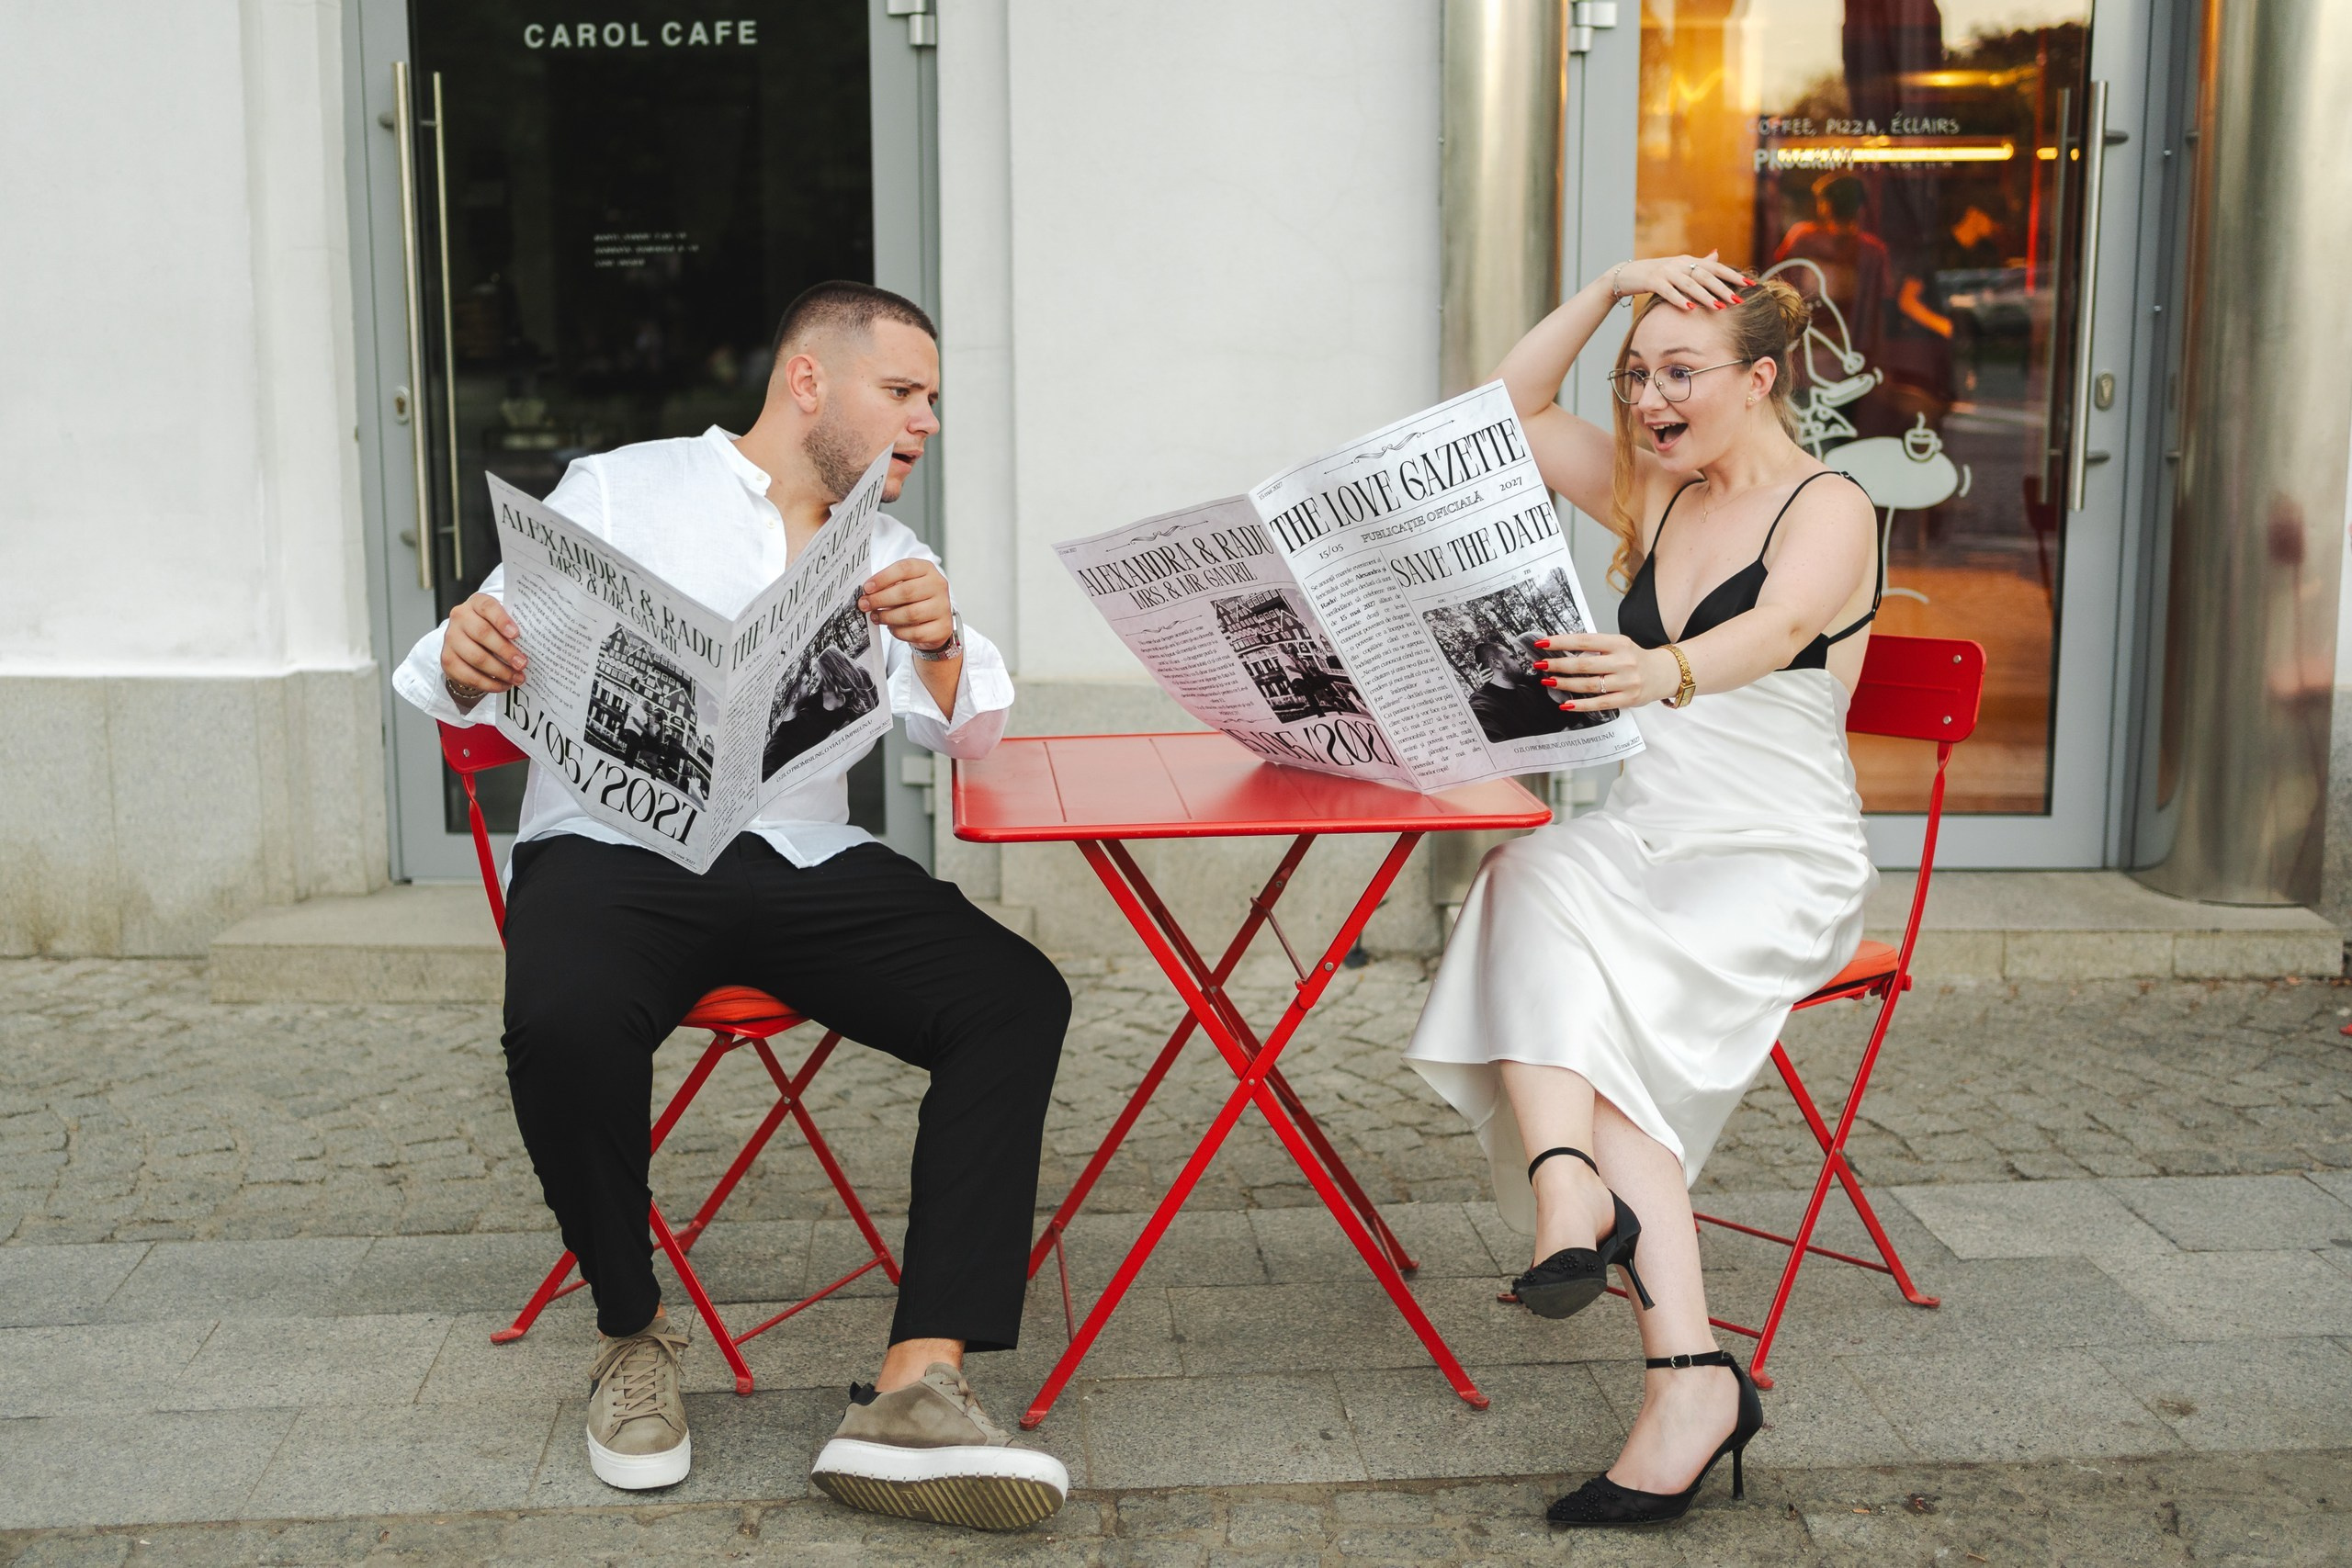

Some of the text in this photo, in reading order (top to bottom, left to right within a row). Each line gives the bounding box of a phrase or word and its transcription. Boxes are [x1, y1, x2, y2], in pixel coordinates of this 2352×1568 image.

[524, 20, 759, 49] CAROL CAFE
[1269, 418, 1526, 554] THE LOVE GAZETTE
[1318, 477, 1523, 559] 15/05 PUBLICAȚIE OFICIALĂ 2027
[502, 502, 633, 603] ALEXANDRA
[640, 589, 656, 620] &
[662, 605, 723, 669] RADU
[732, 615, 766, 671] THE
[769, 558, 816, 634] LOVE
[816, 474, 884, 575] GAZETTE
[1077, 525, 1274, 596] ALEXANDRA & RADU
[1128, 561, 1258, 610] MRS. & MR. GAVRIL
[1390, 502, 1560, 588] SAVE THE DATE
[548, 550, 682, 659] MRS. & MR. GAVRIL
[778, 605, 813, 667] SAVE
[815, 575, 840, 619] THE
[838, 533, 872, 590] DATE
